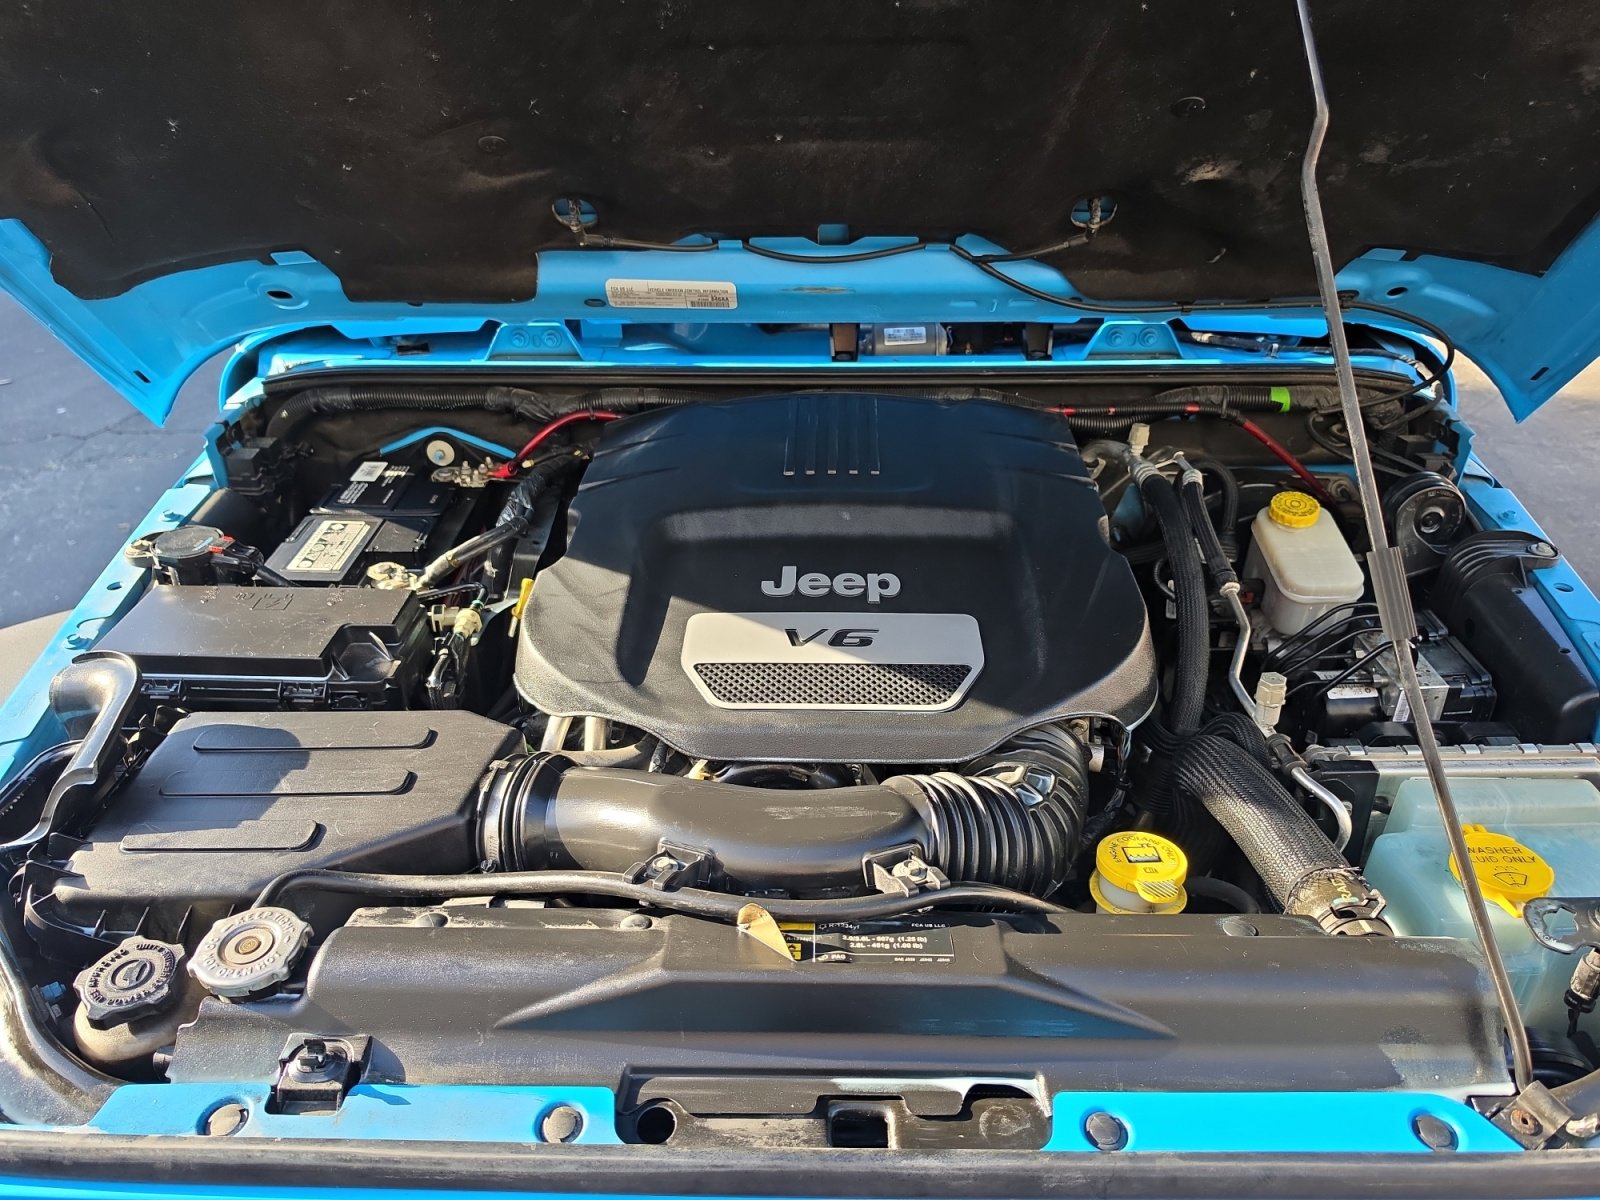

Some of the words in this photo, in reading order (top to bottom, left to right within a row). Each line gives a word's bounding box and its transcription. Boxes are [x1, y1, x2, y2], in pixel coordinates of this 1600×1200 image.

[761, 565, 901, 604] Jeep
[784, 628, 880, 648] V6
[1470, 855, 1499, 864] UID
[1502, 855, 1537, 864] ONLY
[237, 911, 274, 924] KEEP
[274, 912, 296, 933] TIGHT
[218, 966, 254, 979] OPEN
[256, 951, 282, 971] HOT
